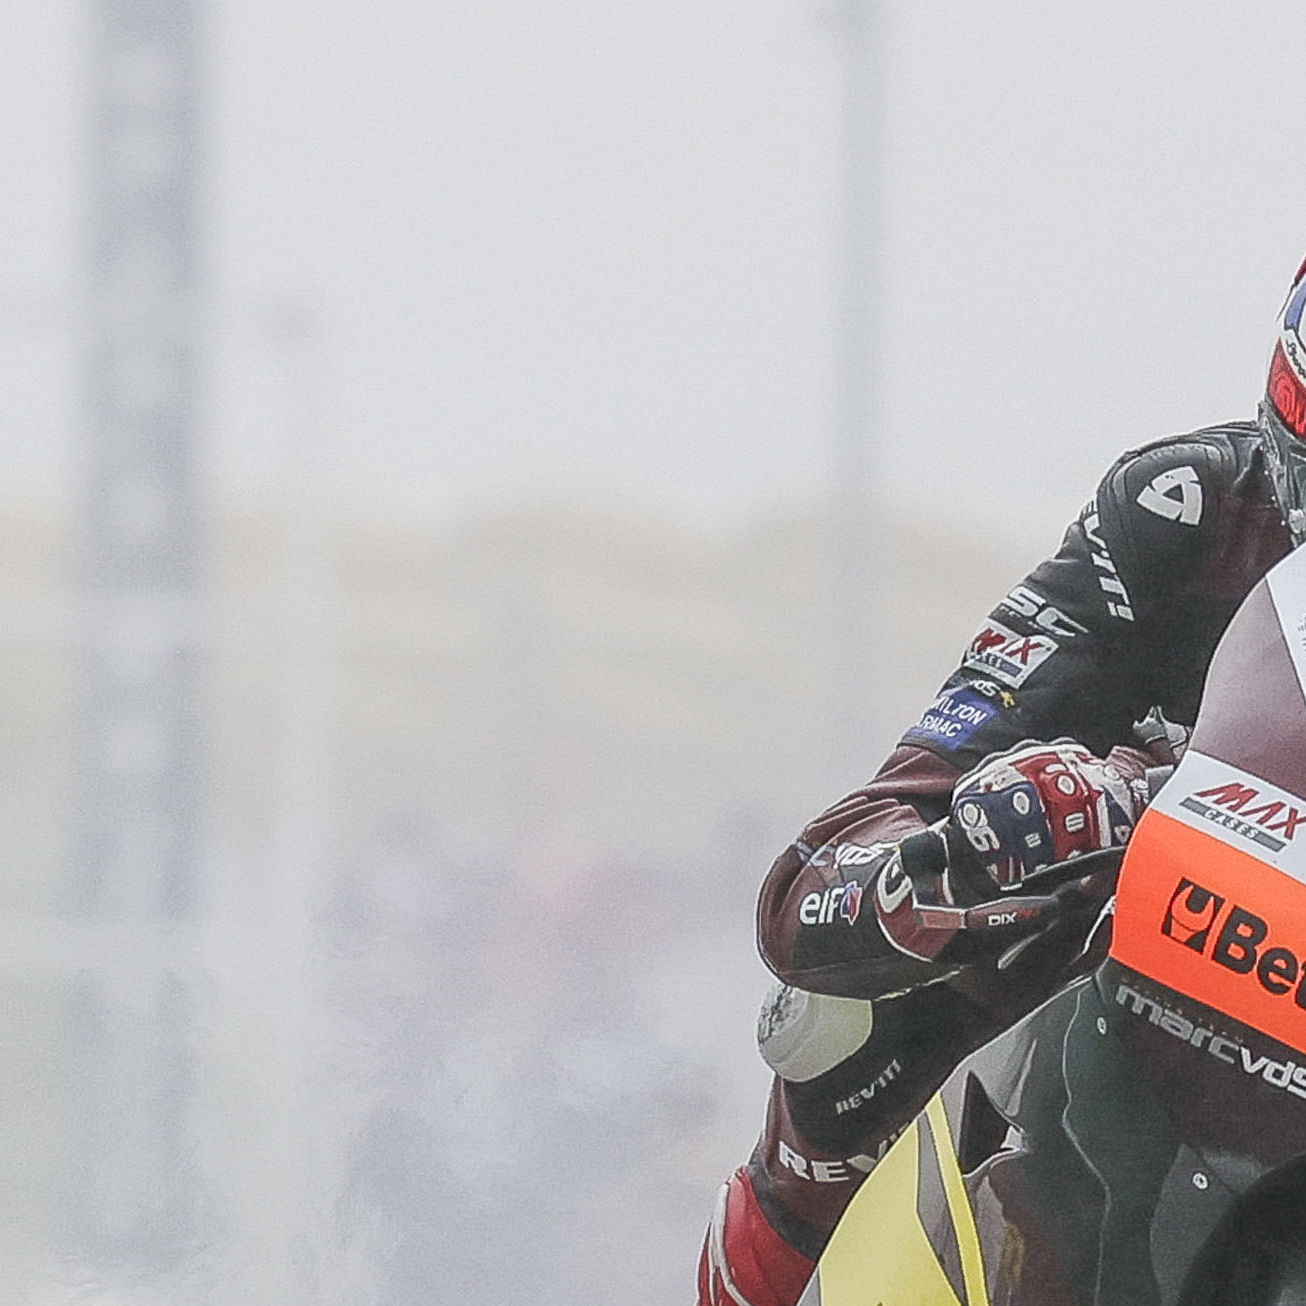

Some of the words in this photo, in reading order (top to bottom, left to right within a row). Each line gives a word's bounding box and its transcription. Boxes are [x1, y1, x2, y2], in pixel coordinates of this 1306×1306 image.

[938, 696, 988, 726] ILTON
[1204, 809, 1260, 839] CASES
[800, 887, 845, 924] elf
